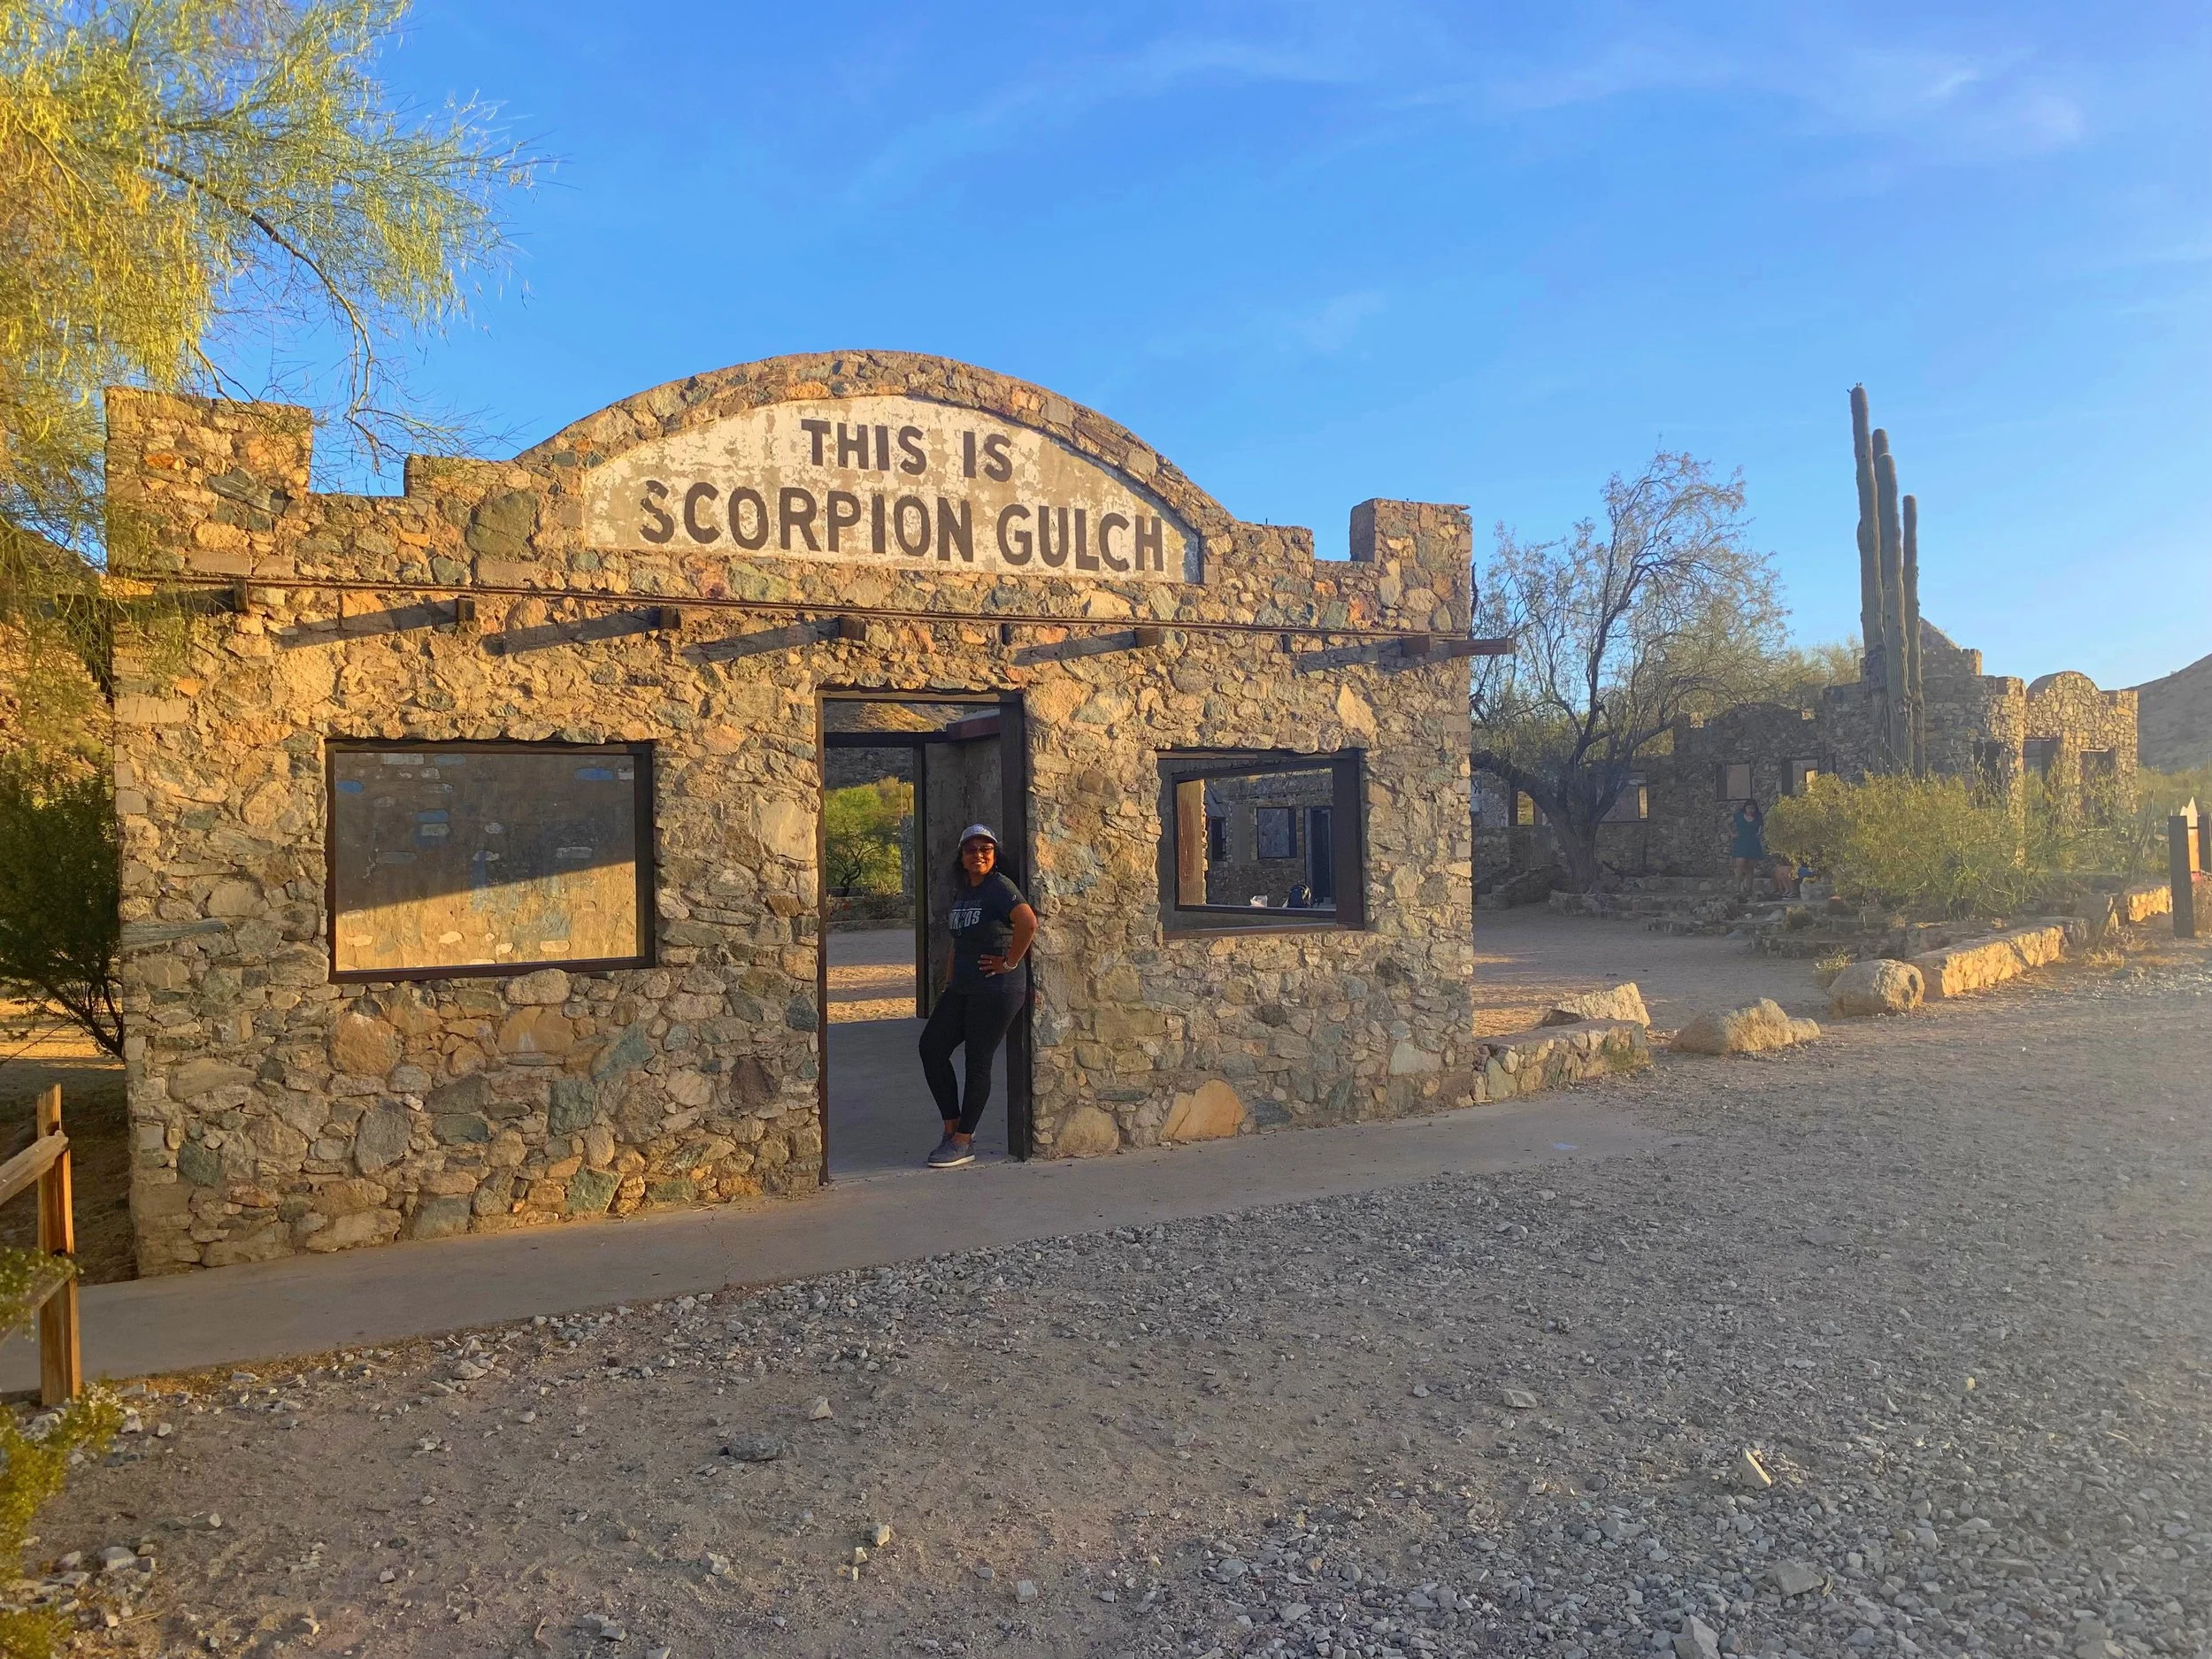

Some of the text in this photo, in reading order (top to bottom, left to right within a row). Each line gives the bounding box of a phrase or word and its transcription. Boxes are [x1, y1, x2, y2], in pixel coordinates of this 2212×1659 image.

[801, 419, 1013, 482] THIS IS
[639, 480, 1164, 572] SCORPION GULCH
